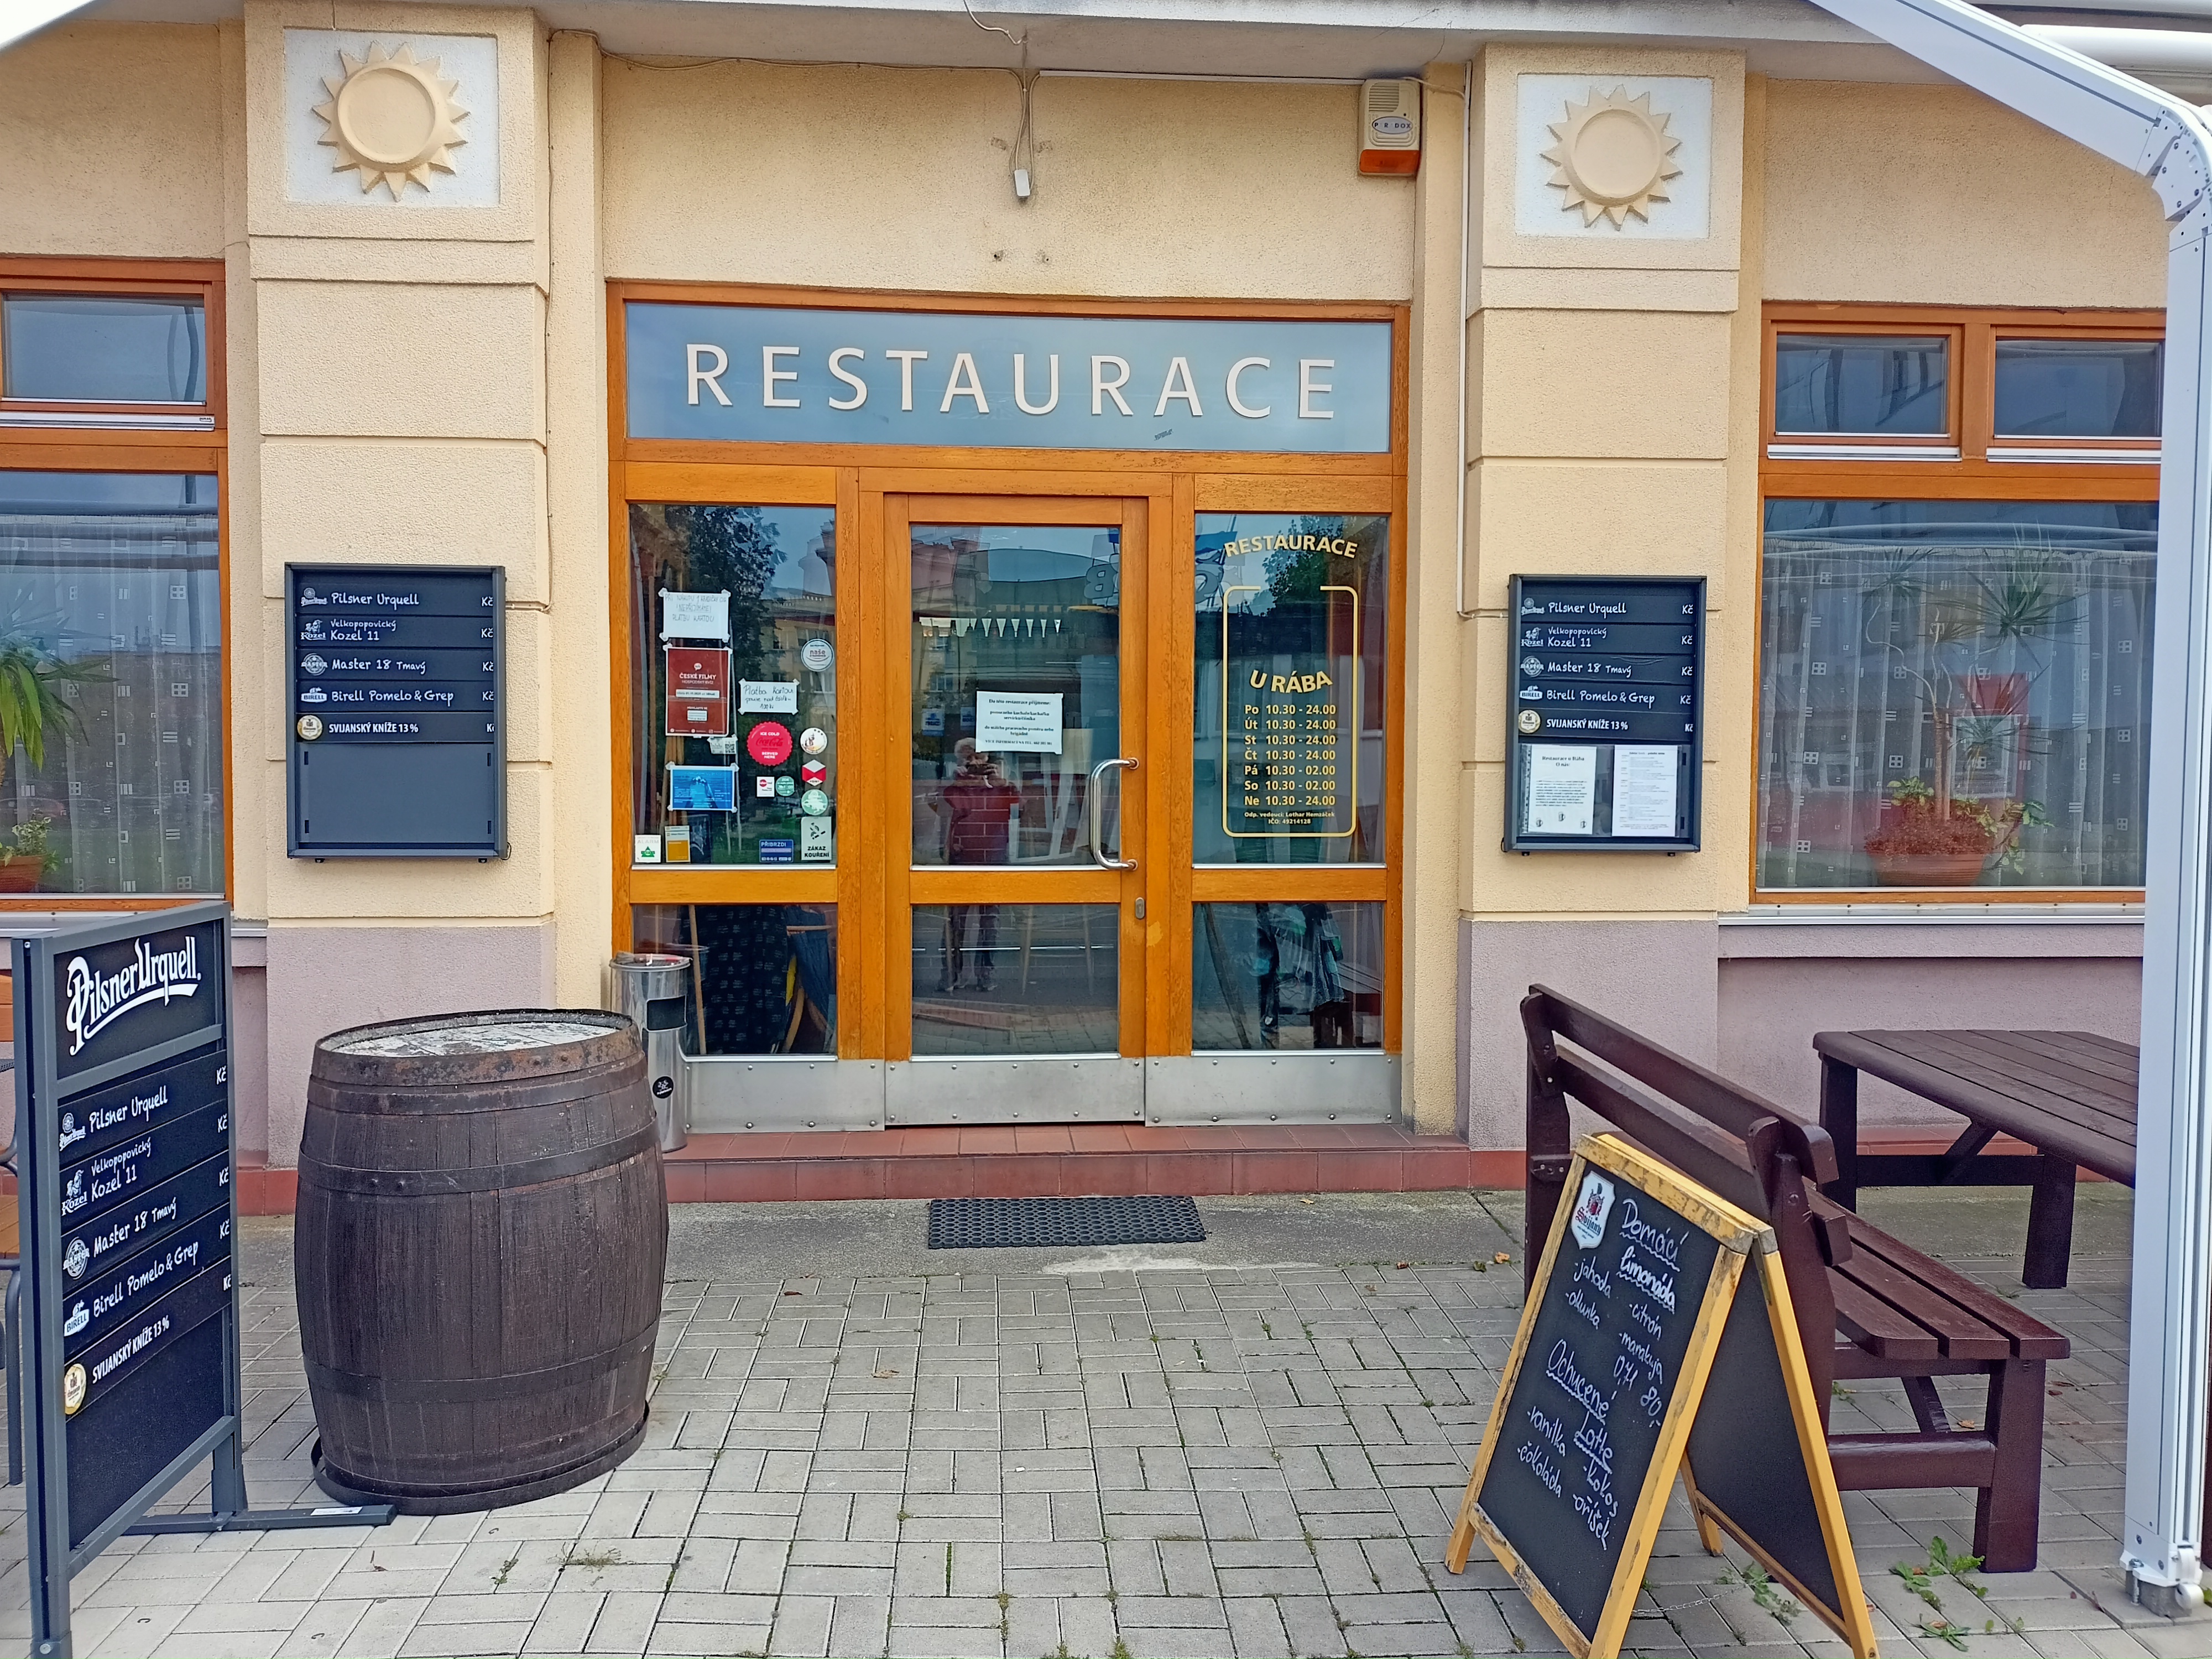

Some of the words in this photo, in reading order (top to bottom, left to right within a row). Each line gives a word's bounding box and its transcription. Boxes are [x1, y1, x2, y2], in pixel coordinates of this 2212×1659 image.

[686, 343, 1335, 419] RESTAURACE
[1224, 535, 1358, 559] RESTAURACE
[331, 592, 373, 604] Pilsner
[377, 593, 419, 610] Urquell
[481, 596, 493, 607] Kč
[1548, 602, 1585, 613] Pilsner
[1589, 602, 1626, 618] Urquell
[1682, 604, 1693, 615] Kč
[331, 618, 397, 632] Velkopopovický
[1548, 626, 1607, 639] Velkopopovický
[331, 629, 363, 640] Kozel
[367, 630, 380, 640] 11
[481, 628, 493, 638] Kč
[1548, 637, 1576, 647] Kozel
[1580, 638, 1592, 647] 11
[1682, 635, 1693, 645] Kč
[332, 658, 371, 670] Master
[376, 660, 390, 670] 18
[397, 661, 427, 674] Tmavý
[1548, 661, 1583, 672] Master
[1588, 663, 1600, 672] 18
[1605, 665, 1632, 678] Tmavý
[1682, 666, 1693, 676] Kč
[743, 684, 767, 695] Platba
[1250, 670, 1268, 689] U
[1271, 670, 1333, 693] RÁBA
[332, 690, 364, 702] Birell
[369, 690, 411, 701] Pomelo
[414, 691, 422, 701] &
[424, 690, 454, 707] Grep
[482, 691, 494, 701] Kč
[1547, 689, 1575, 700] Birell
[1580, 690, 1618, 702] Pomelo
[1619, 692, 1627, 702] &
[1629, 692, 1655, 709] Grep
[1680, 695, 1691, 705] Kč
[1245, 705, 1259, 714] Po
[1266, 705, 1296, 714] 10.30
[1306, 705, 1336, 714] 24.00
[328, 722, 371, 733] SVIJANSKÝ
[372, 721, 397, 733] KNÍŽE
[1245, 717, 1258, 729] Út
[1266, 719, 1296, 729] 10.30
[1306, 719, 1336, 729] 24.00
[1546, 718, 1587, 729] SVIJANSKÝ
[1588, 719, 1609, 730] KNÍŽE
[1684, 723, 1693, 732] Kč
[756, 737, 783, 747] Coca-Cola
[1245, 735, 1256, 745] St
[1266, 735, 1296, 745] 10.30
[1306, 735, 1336, 745] 24.00
[1245, 747, 1258, 760] Čt
[1266, 750, 1296, 760] 10.30
[1306, 750, 1336, 760] 24.00
[1245, 764, 1258, 775] Pá
[1266, 765, 1296, 775] 10.30
[1306, 765, 1336, 775] 02.00
[1245, 780, 1259, 790] So
[1266, 780, 1296, 790] 10.30
[1306, 780, 1336, 790] 02.00
[1245, 796, 1259, 806] Ne
[1266, 796, 1296, 806] 10.30
[1306, 796, 1336, 806] 24.00
[66, 956, 137, 1056] Pilsner
[89, 1108, 127, 1133] Pilsner
[131, 1085, 168, 1122] Urquell
[217, 1066, 227, 1085] Kč
[91, 1137, 152, 1176] Velkopopovický
[217, 1113, 227, 1133] Kč
[91, 1172, 122, 1202] Kozel
[126, 1166, 137, 1184] 11
[219, 1166, 229, 1187] Kč
[61, 1192, 88, 1217] Kozel
[93, 1223, 131, 1258] Master
[134, 1211, 147, 1233] 18
[151, 1197, 177, 1223] Tmavý
[220, 1219, 229, 1239] Kč
[1622, 1198, 1689, 1262] Domácí
[93, 1283, 123, 1318] Birell
[127, 1263, 164, 1294] Pomelo
[165, 1254, 173, 1270] &
[174, 1241, 199, 1266] Grep
[223, 1275, 231, 1291] Kč
[66, 1313, 87, 1333] BIRELL
[92, 1338, 132, 1384] SVIJANSKÝ
[132, 1326, 153, 1353] KNÍŽE
[1575, 1411, 1613, 1460] Latte
